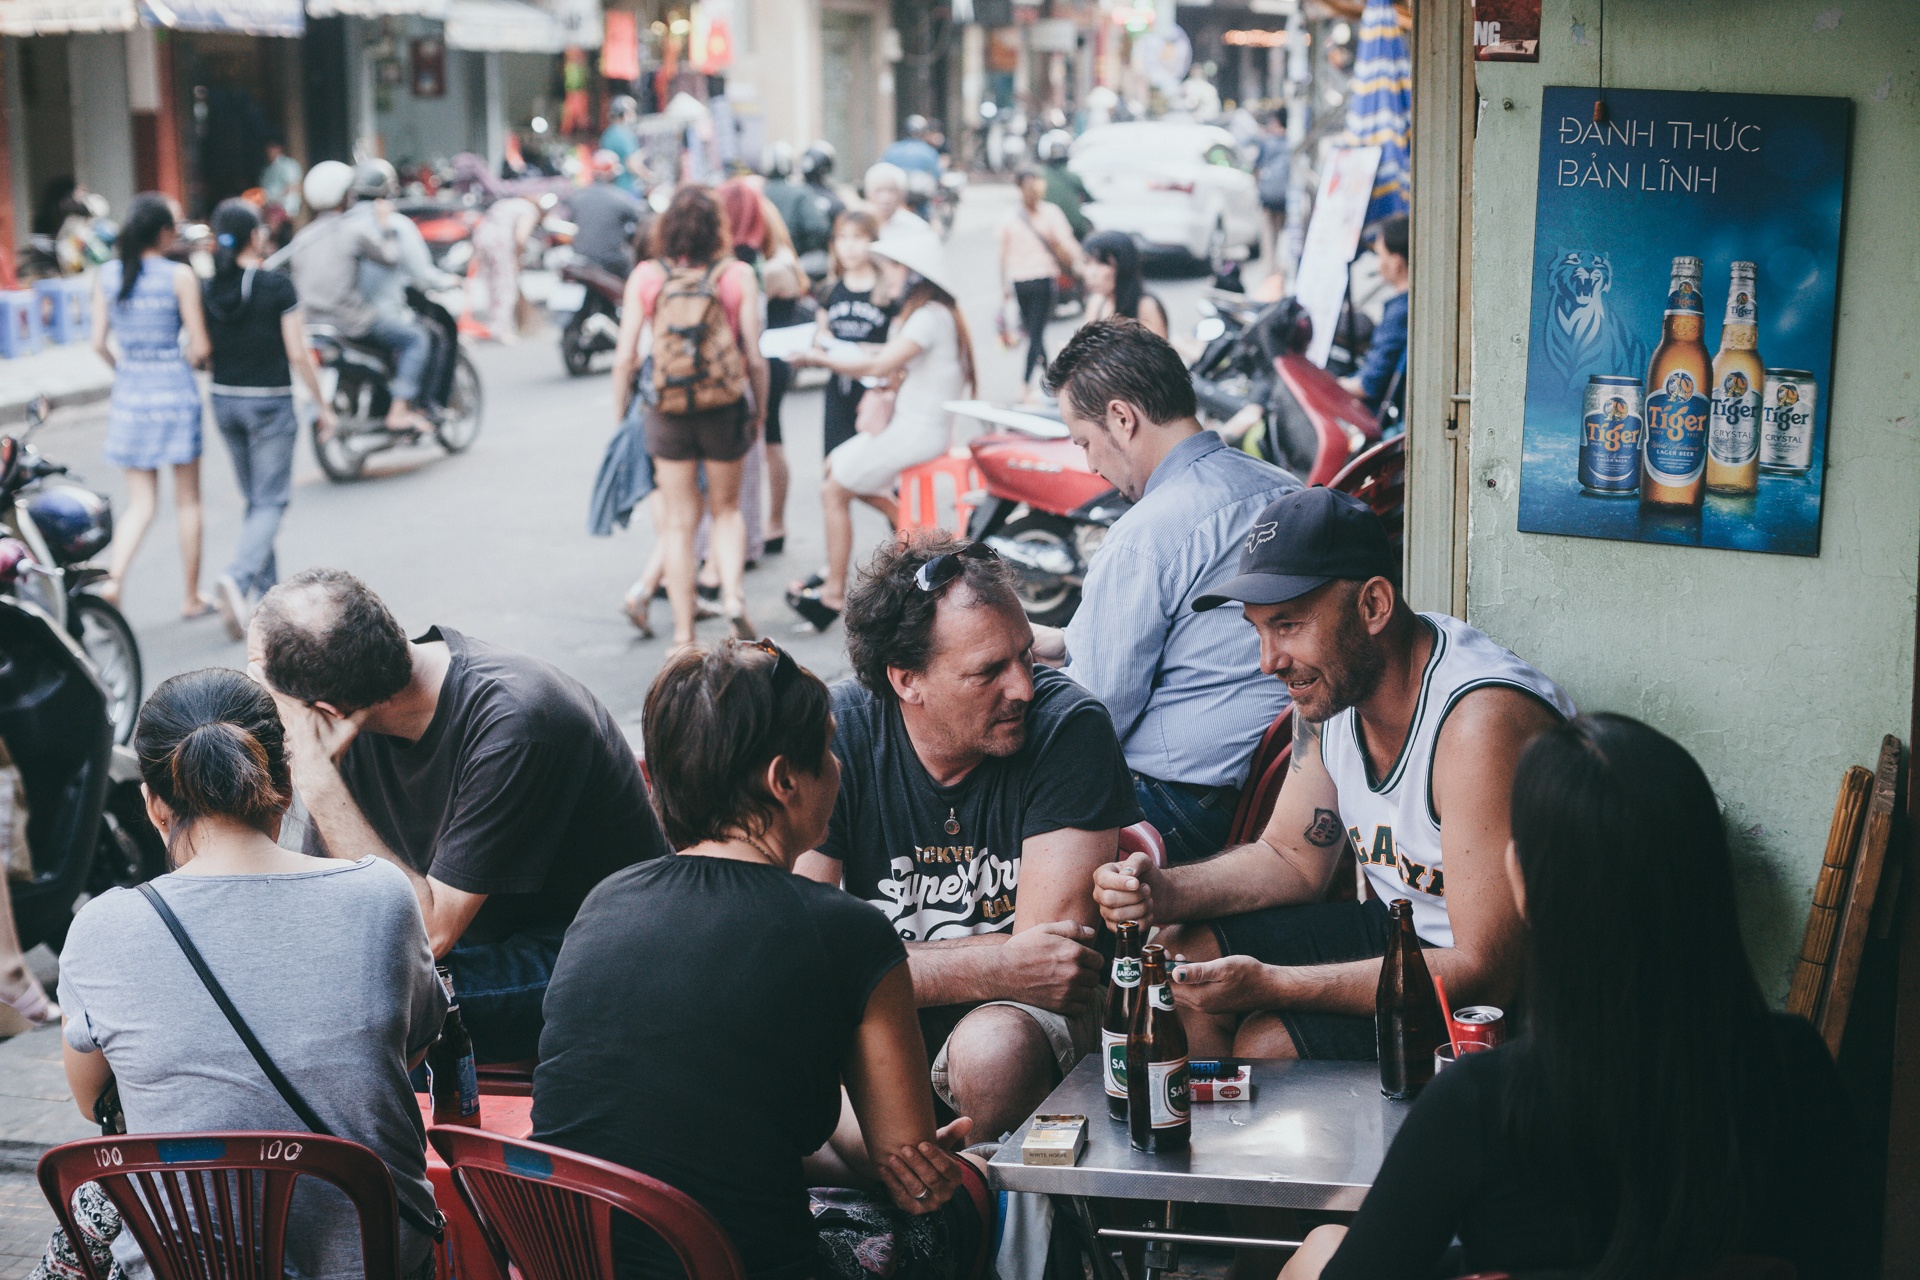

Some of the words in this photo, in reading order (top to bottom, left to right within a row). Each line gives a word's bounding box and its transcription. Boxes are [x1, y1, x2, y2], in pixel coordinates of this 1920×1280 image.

[1668, 117, 1761, 152] THỨC
[1558, 153, 1629, 188] BẢN
[1642, 158, 1717, 193] LĨNH
[1731, 305, 1753, 317] Tiger
[1649, 405, 1707, 441] Tiger
[1711, 398, 1758, 425] Tiger
[1764, 406, 1809, 431] Tiger
[1587, 423, 1639, 452] Tiger
[1714, 430, 1752, 438] CRYSTAL
[1765, 434, 1802, 443] CRYSTAL
[915, 845, 974, 864] TOKYO
[94, 1146, 123, 1167] 100
[260, 1139, 303, 1161] 100
